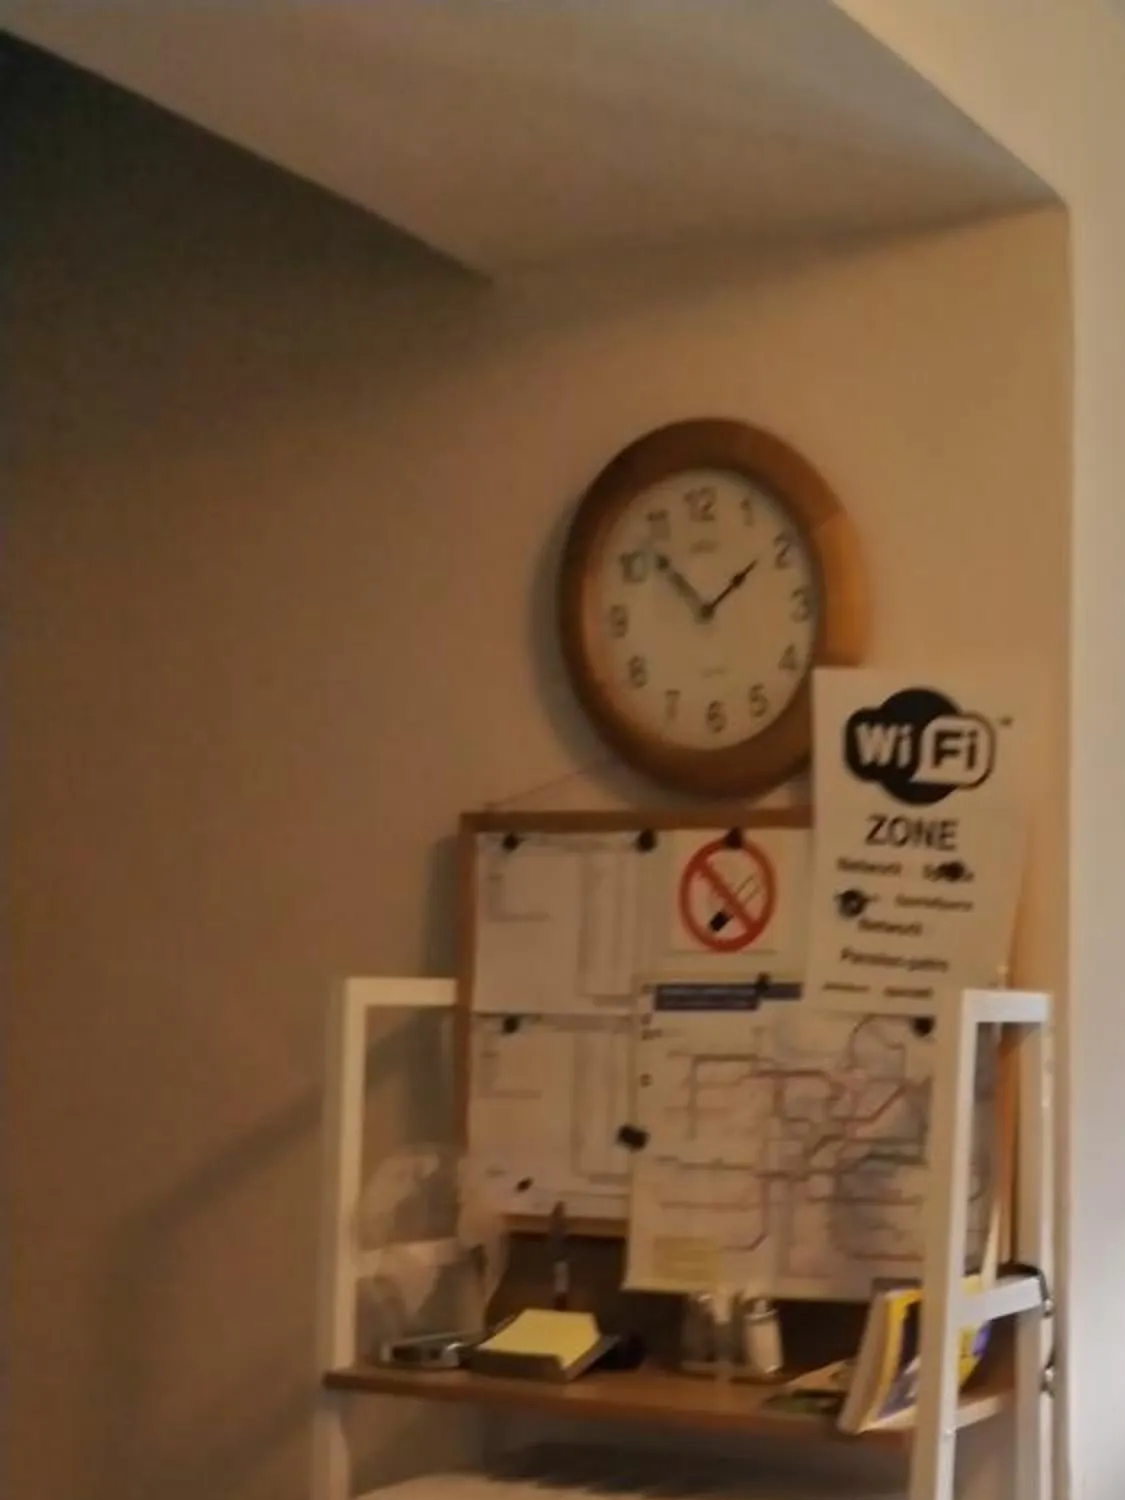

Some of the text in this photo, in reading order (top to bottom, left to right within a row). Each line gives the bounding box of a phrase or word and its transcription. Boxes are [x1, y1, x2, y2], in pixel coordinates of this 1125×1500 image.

[684, 486, 717, 522] 12
[740, 497, 755, 527] 1
[618, 550, 649, 584] 10
[774, 530, 795, 570] 2
[609, 604, 628, 639] 9
[791, 587, 810, 623] 3
[627, 655, 647, 689] 8
[778, 644, 799, 673] 4
[664, 688, 682, 723] 7
[706, 699, 727, 734] 6
[749, 683, 769, 718] 5
[866, 813, 959, 851] ZONE
